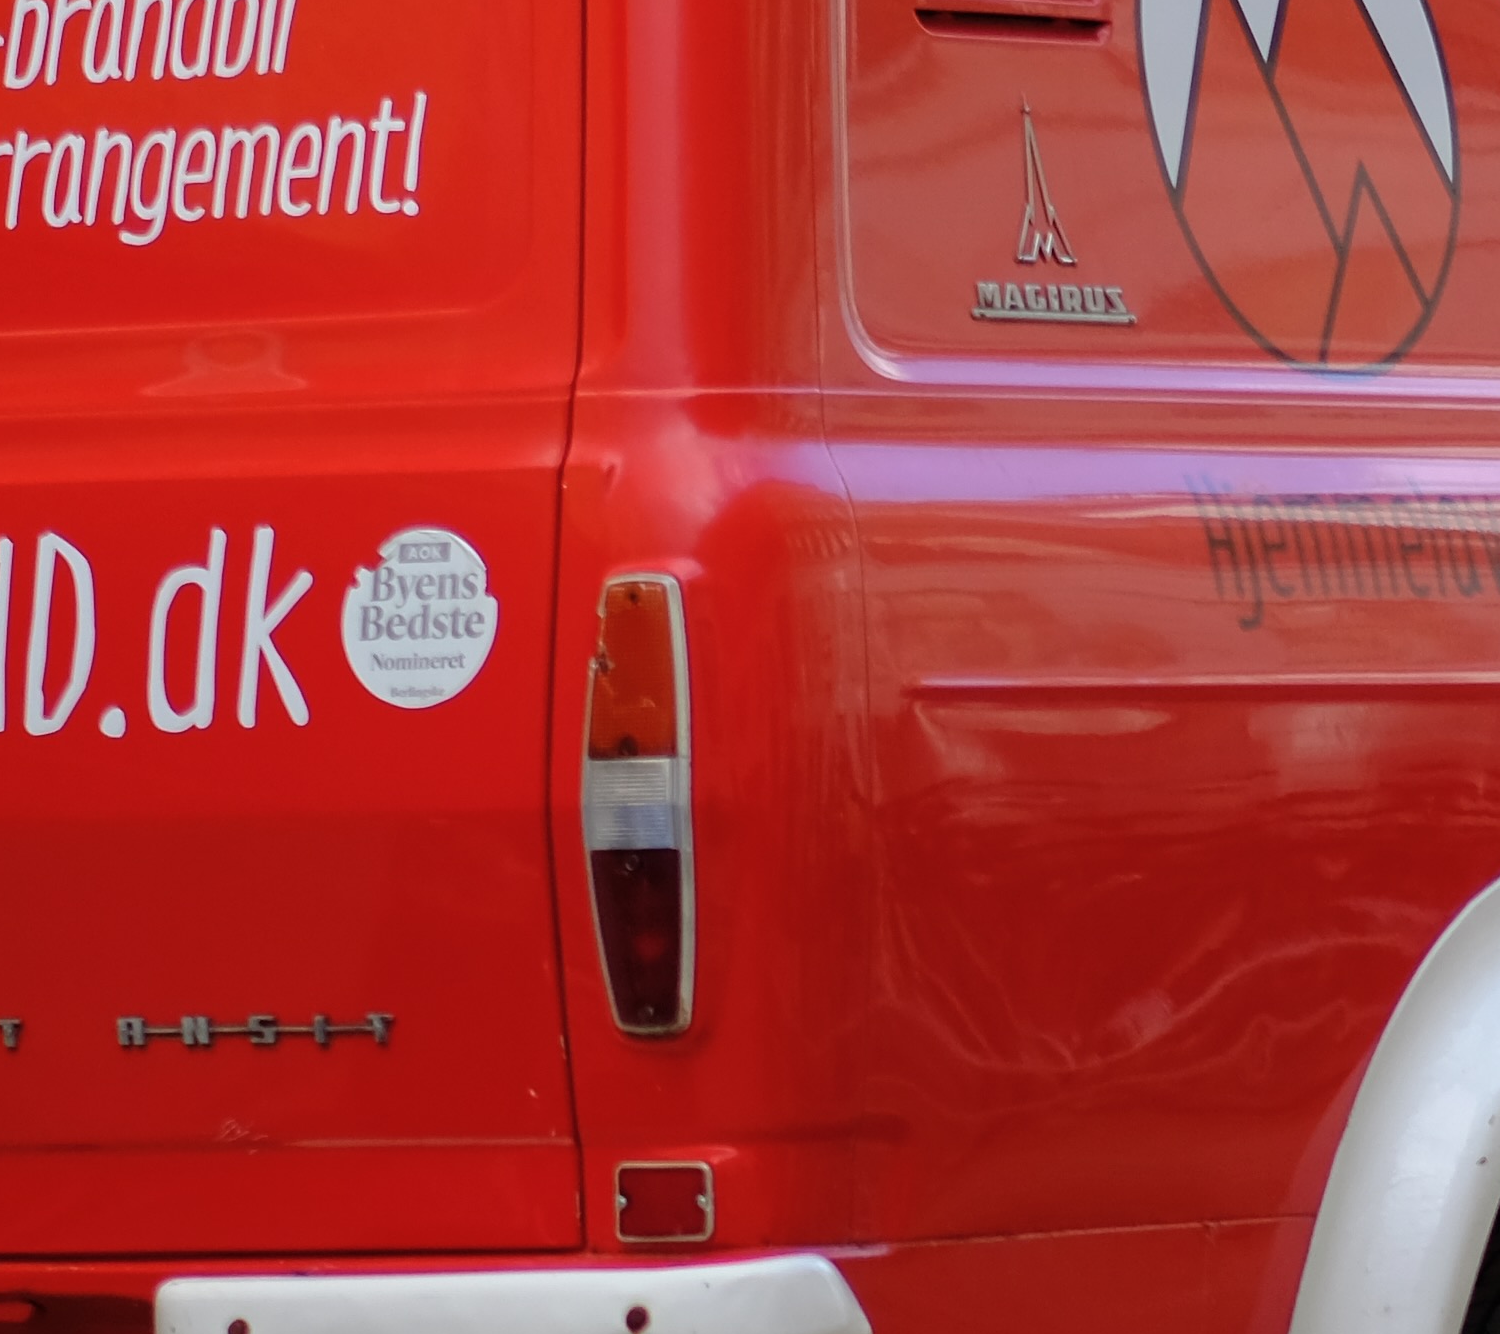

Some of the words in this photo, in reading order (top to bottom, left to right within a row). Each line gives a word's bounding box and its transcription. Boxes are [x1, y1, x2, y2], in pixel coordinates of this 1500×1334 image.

[977, 280, 1128, 313] MAGIRUS
[406, 545, 445, 560] AOK
[369, 566, 479, 609] Byens
[358, 604, 486, 642] Bedste
[370, 652, 468, 671] Nomineret
